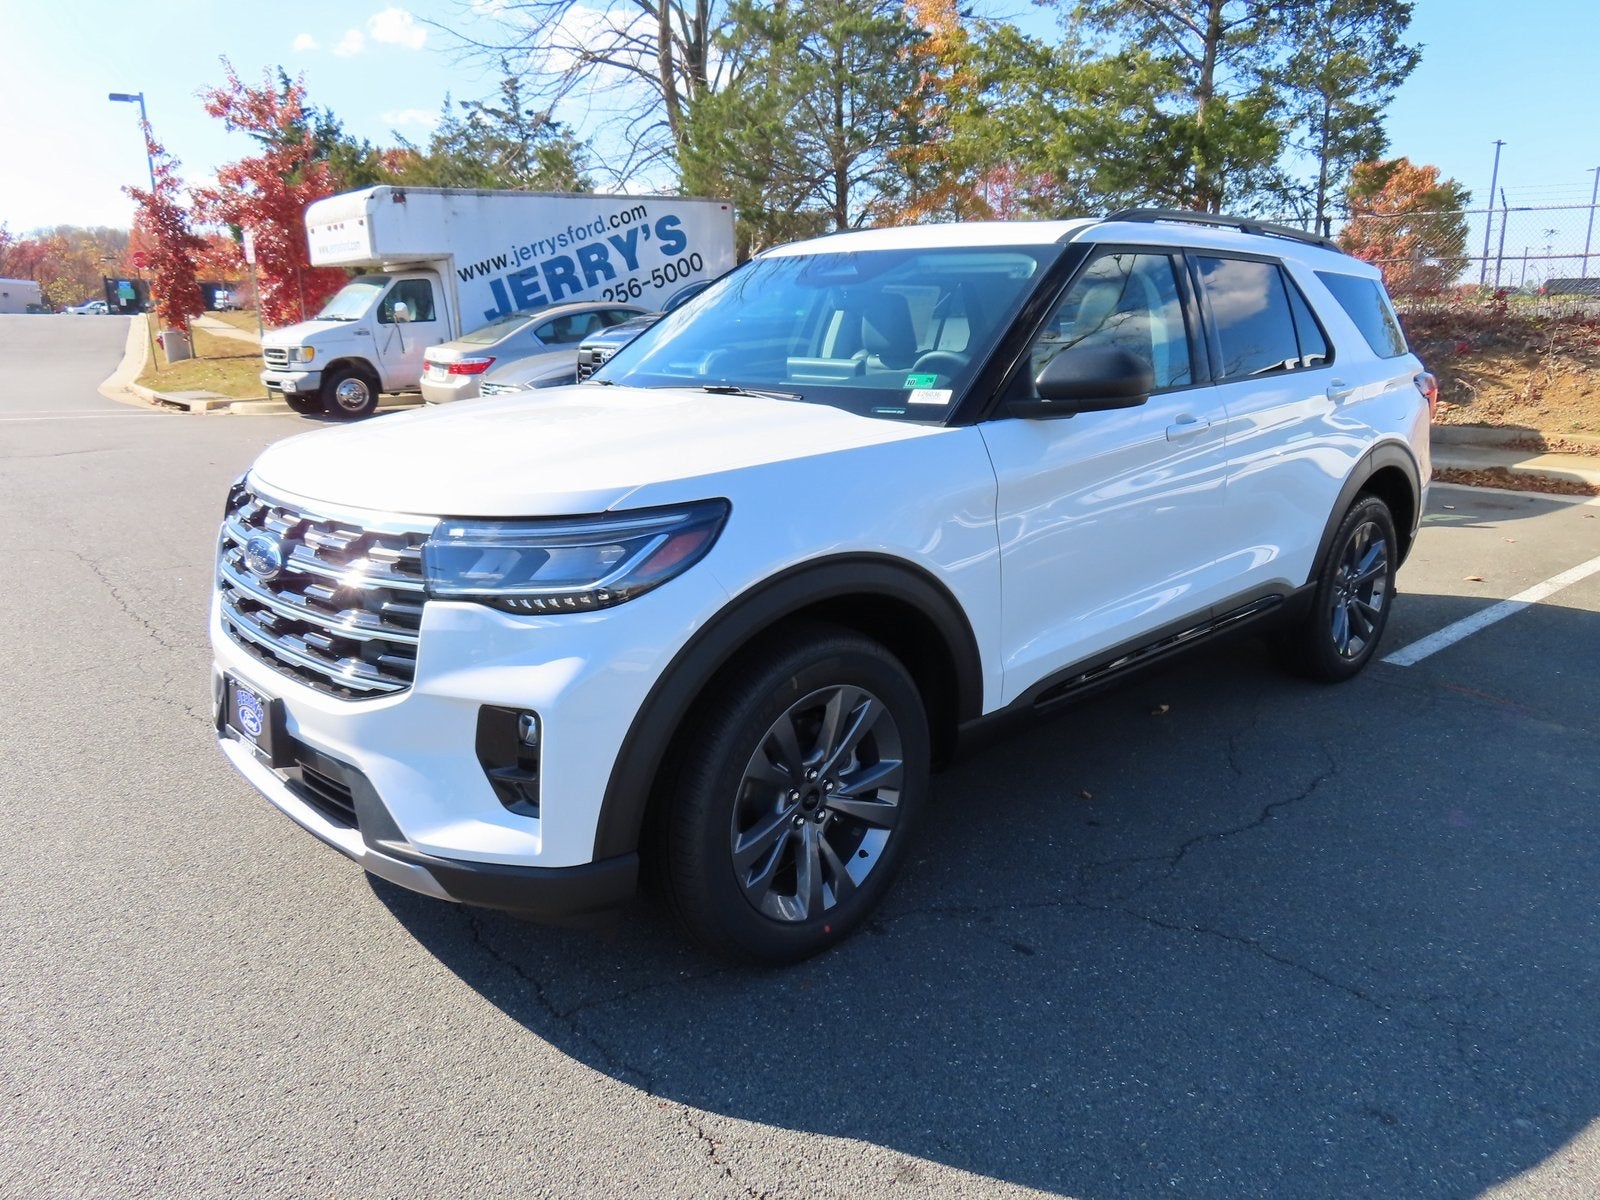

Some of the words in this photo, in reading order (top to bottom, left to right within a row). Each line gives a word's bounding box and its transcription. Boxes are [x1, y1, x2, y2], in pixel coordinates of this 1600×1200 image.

[457, 205, 648, 282] www.jerrysford.com
[484, 214, 688, 322] JERRY'S
[602, 252, 703, 304] 256-5000
